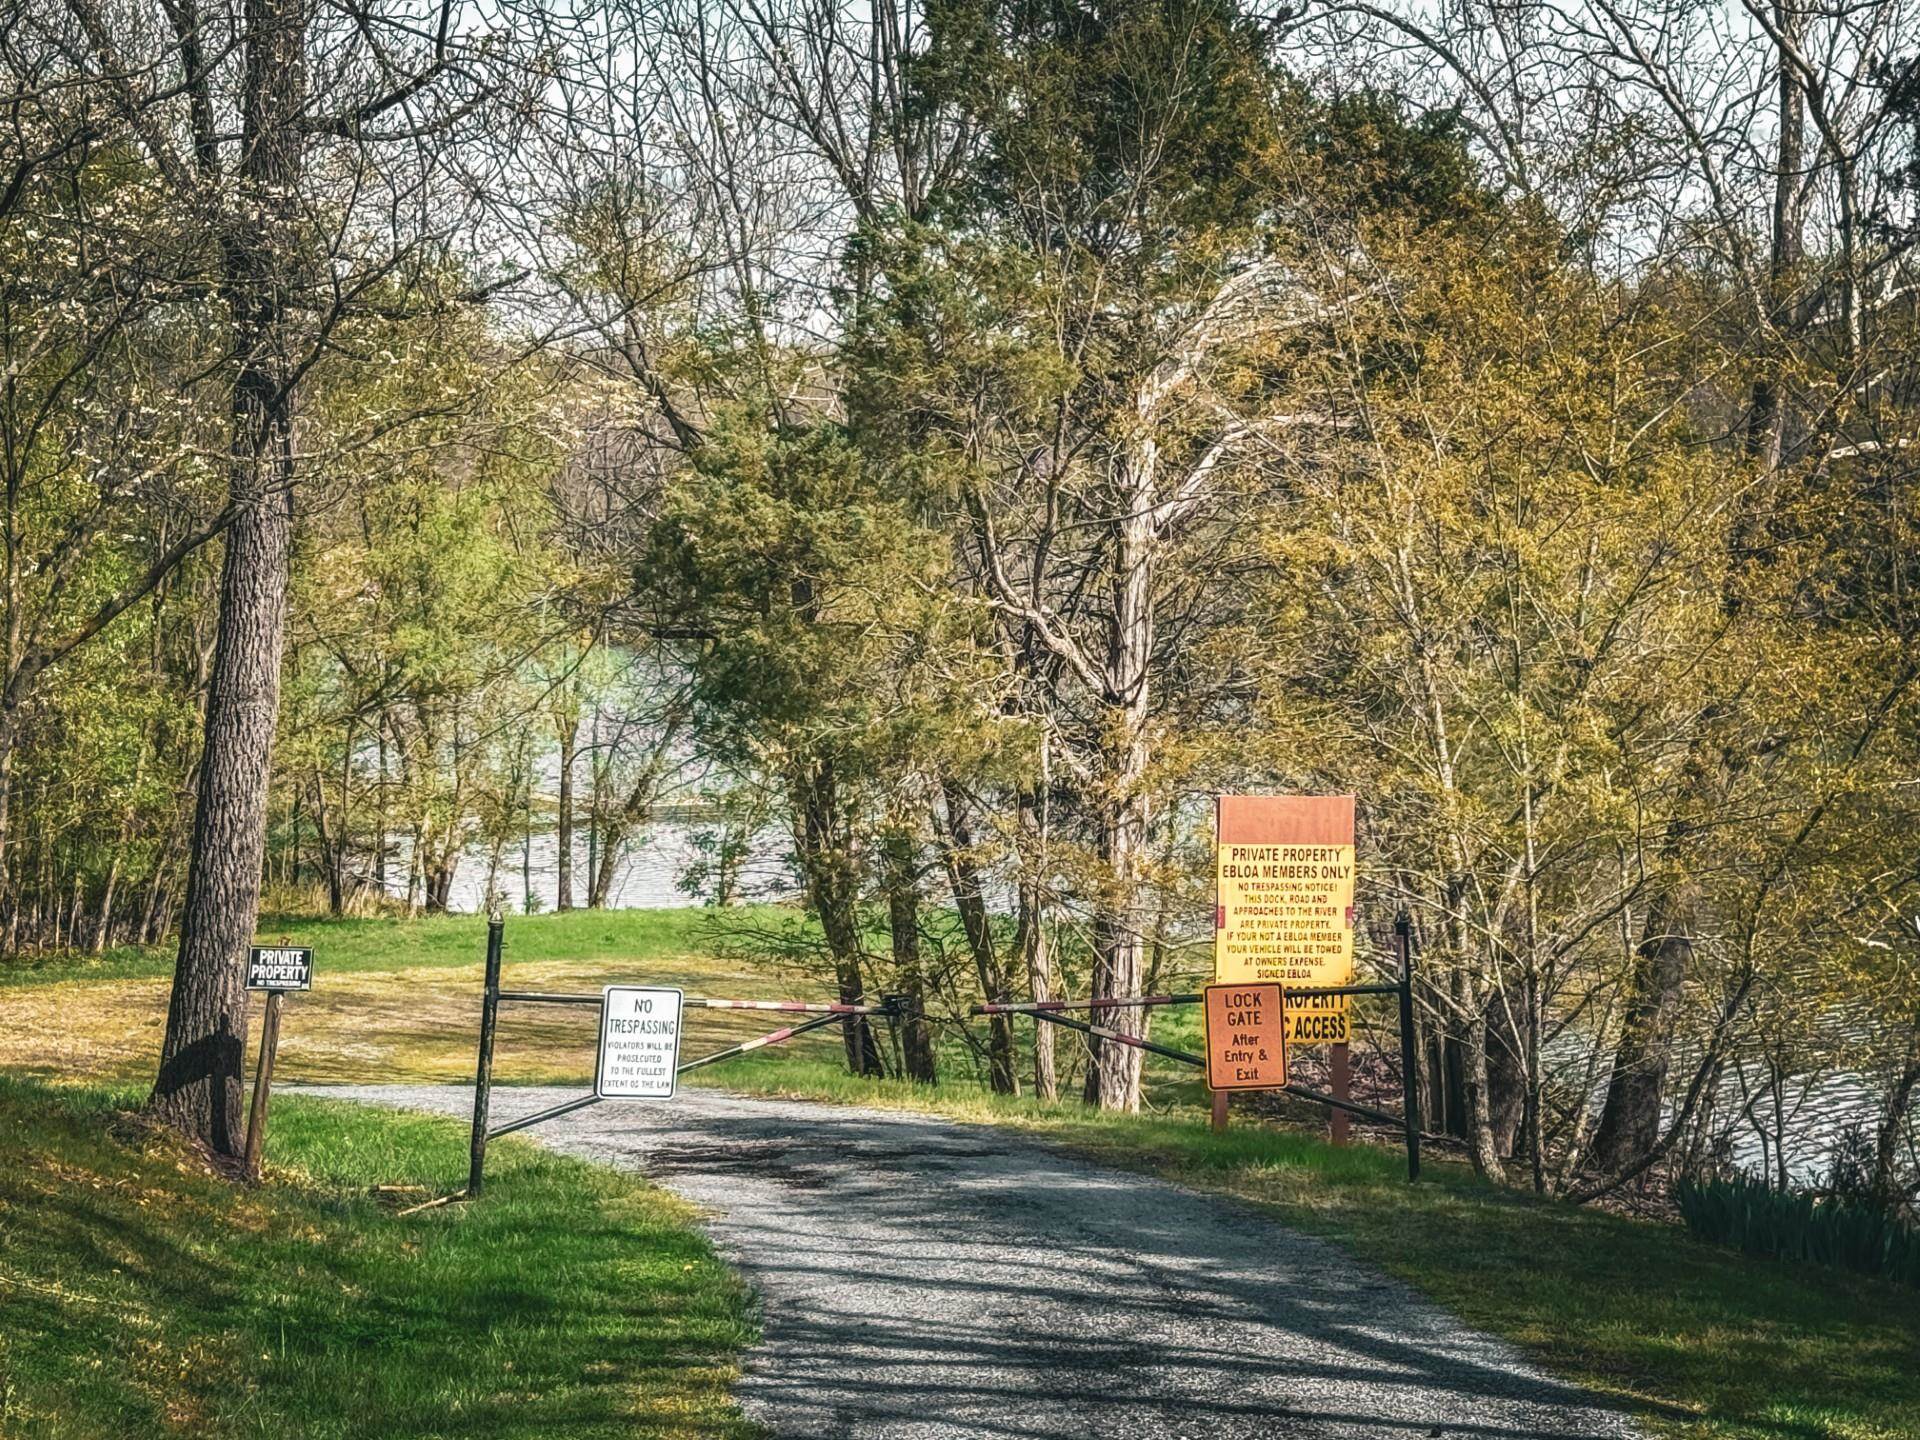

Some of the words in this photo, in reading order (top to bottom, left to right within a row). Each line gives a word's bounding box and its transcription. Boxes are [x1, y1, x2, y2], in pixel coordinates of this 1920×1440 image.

[1232, 848, 1279, 862] PRIVATE
[1283, 848, 1341, 862] PROPERTY
[1222, 865, 1259, 878] EBLOA
[1262, 865, 1318, 879] MEMBERS
[1321, 866, 1351, 879] ONLY
[1238, 883, 1249, 891] NO
[1252, 883, 1303, 892] TRESPASSING
[1305, 883, 1338, 892] NOTICE!
[1244, 894, 1262, 903] THIS
[1289, 895, 1310, 903] ROAD
[1311, 895, 1328, 904] AND
[1233, 907, 1284, 916] APPROACHES
[1286, 907, 1296, 916] TO
[1298, 907, 1312, 916] THE
[1314, 907, 1337, 916] RIVER
[1240, 920, 1255, 929] ARE
[1257, 920, 1288, 929] PRIVATE
[1226, 932, 1234, 941] IF
[1236, 932, 1257, 941] YOUR
[1259, 932, 1275, 941] NOT
[1276, 932, 1282, 941] A
[1284, 932, 1308, 941] EBLOA
[1310, 932, 1342, 941] MEMBER
[1226, 945, 1247, 954] YOUR
[1249, 945, 1281, 954] VEHICLE
[1284, 945, 1301, 953] WILL
[1304, 945, 1313, 953] BE
[1316, 945, 1342, 954] TOWED
[259, 949, 303, 965] PRIVATE
[1244, 957, 1253, 966] AT
[1255, 957, 1287, 966] OWNERS
[251, 964, 308, 980] PROPERTY
[1257, 969, 1285, 978] SIGNED
[1287, 969, 1312, 978] EBLOA
[1225, 992, 1262, 1008] LOCK
[634, 998, 653, 1014] NO
[1227, 1011, 1262, 1026] GATE
[609, 1019, 675, 1035] TRESPASSING
[1294, 1016, 1345, 1039] ACCESS
[608, 1041, 644, 1049] VIOLATORS
[647, 1042, 662, 1050] WILL
[1232, 1034, 1260, 1046] After
[617, 1053, 662, 1063] PROSECUTED
[1225, 1050, 1254, 1063] Entry
[1259, 1049, 1268, 1061] &
[611, 1066, 619, 1075] TO
[622, 1066, 634, 1075] THE
[636, 1067, 666, 1076] FULLEST
[1236, 1068, 1259, 1081] Exit
[604, 1080, 628, 1088] EXTENT
[641, 1080, 654, 1088] THE
